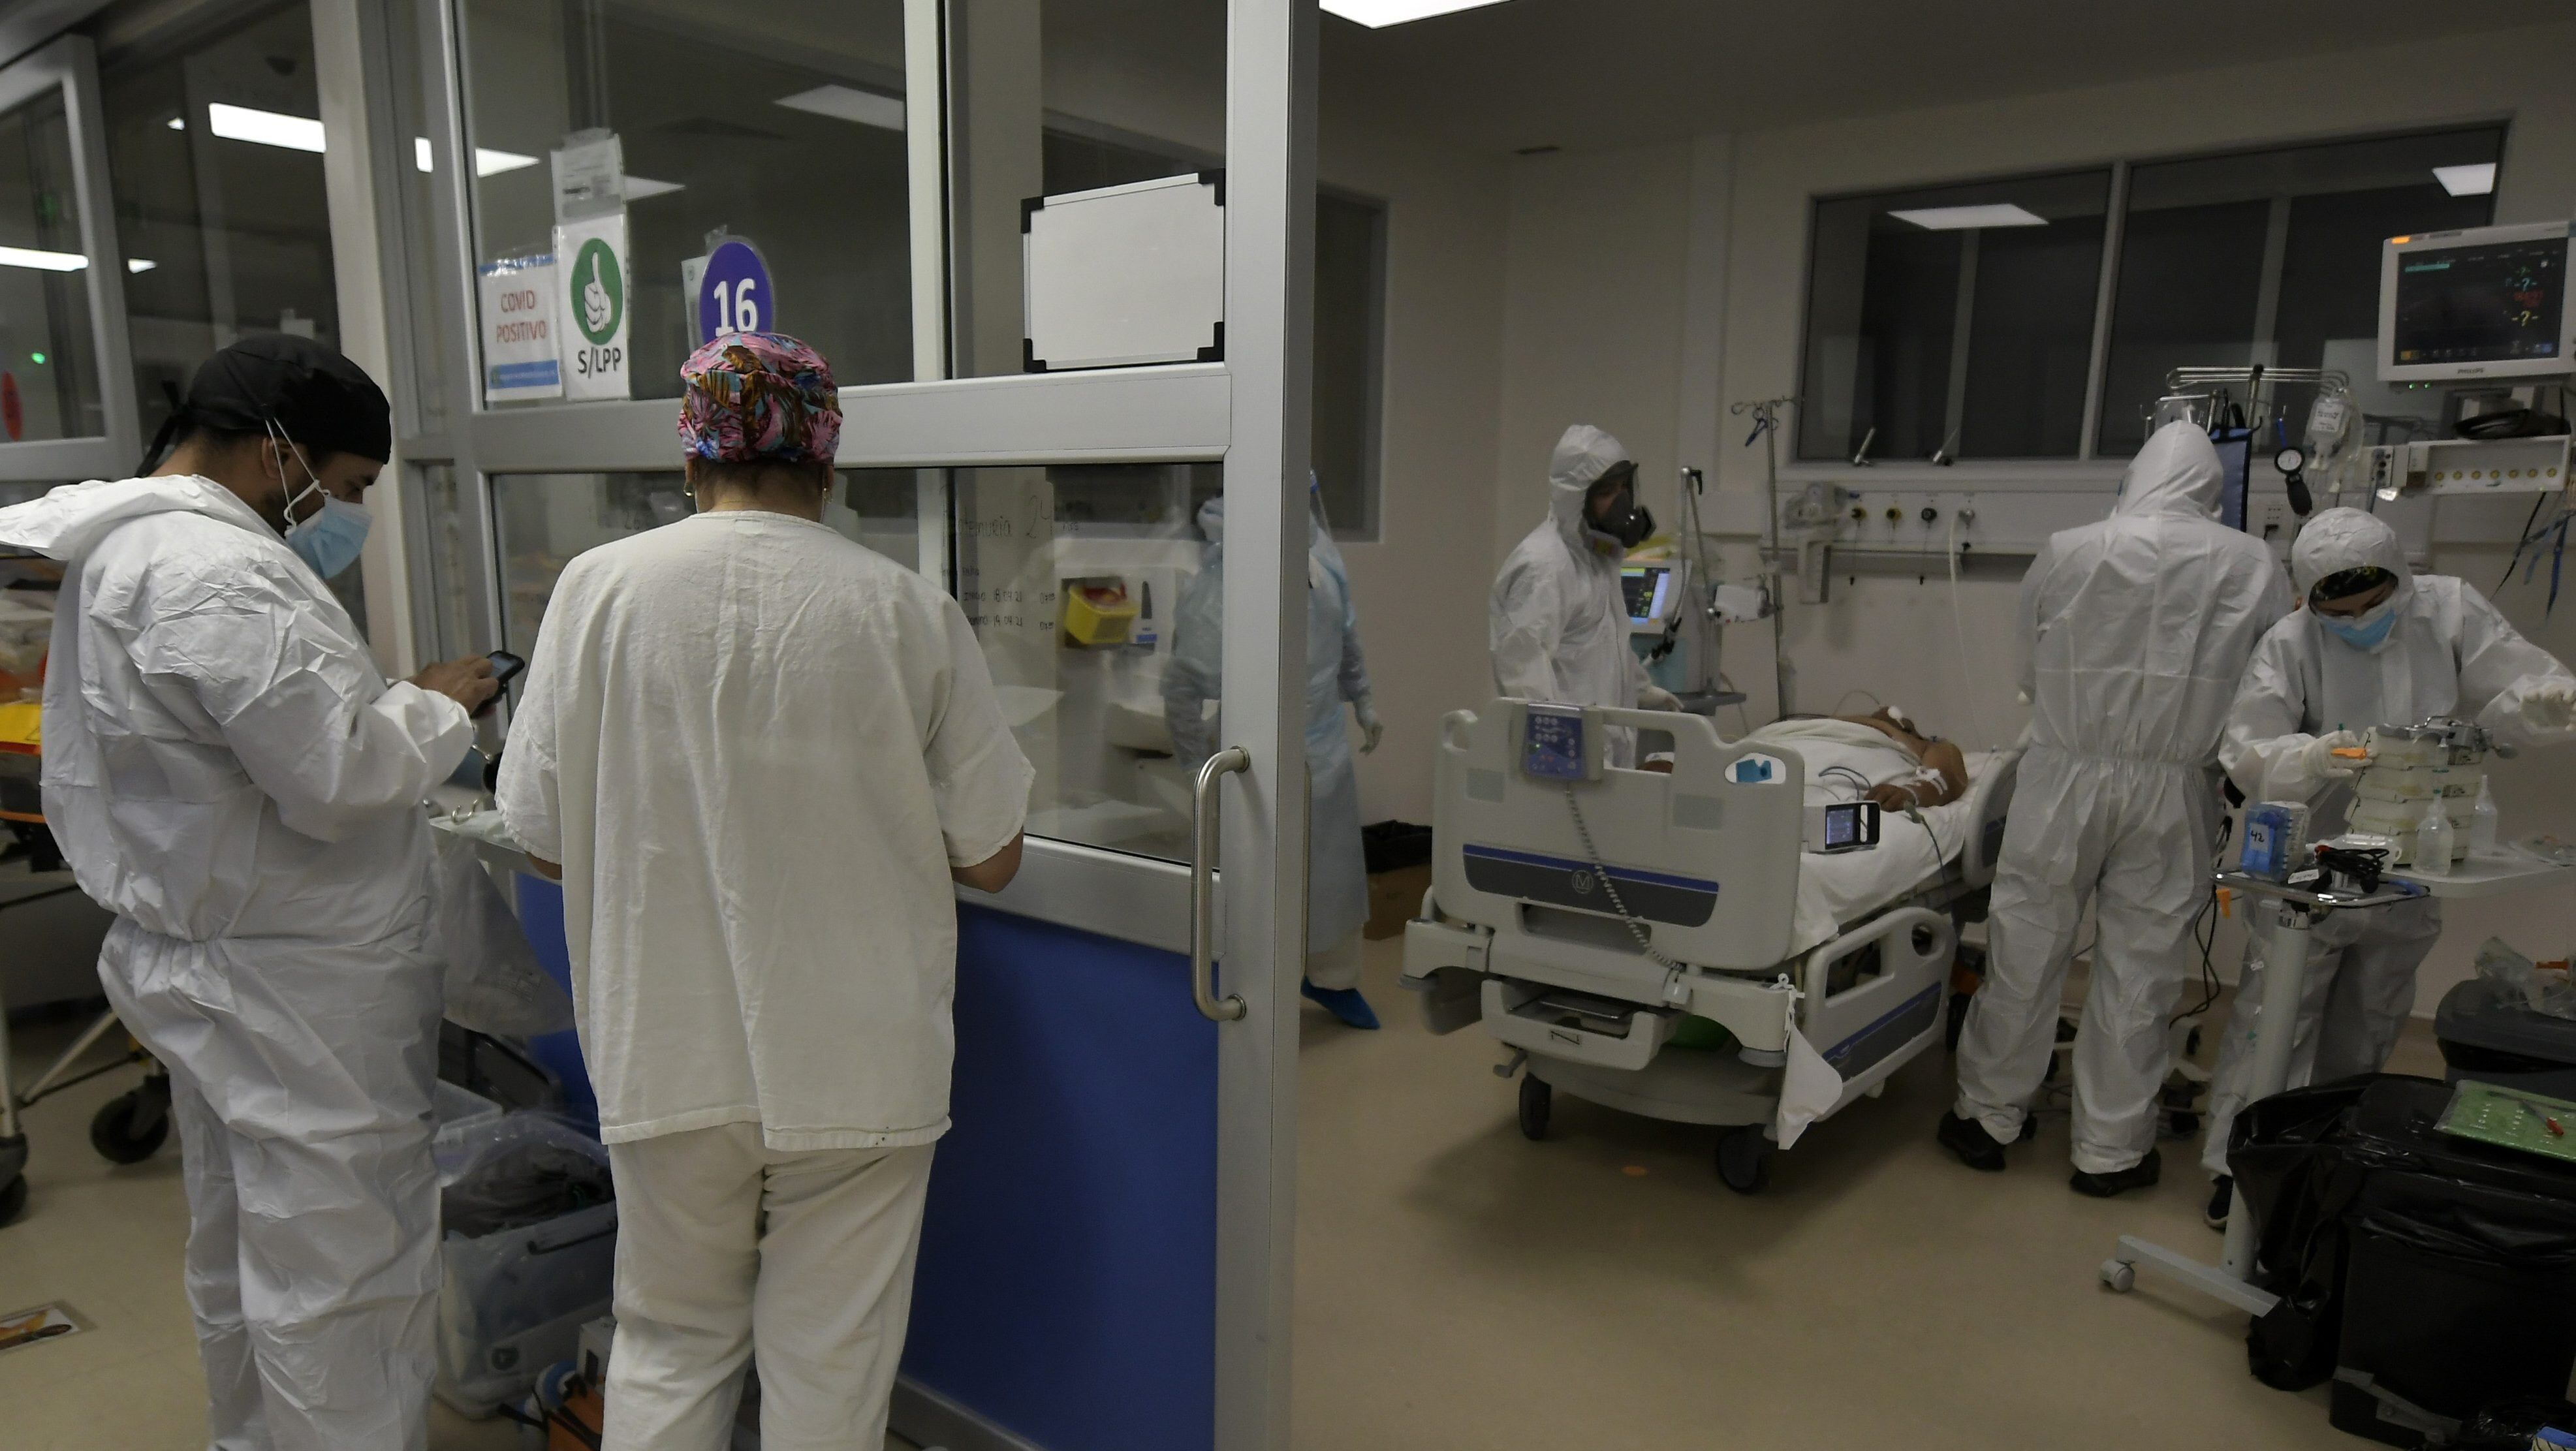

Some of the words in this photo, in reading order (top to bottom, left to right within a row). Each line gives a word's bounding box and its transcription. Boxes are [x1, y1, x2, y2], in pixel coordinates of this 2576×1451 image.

[501, 290, 535, 313] COVID
[714, 278, 757, 337] 16
[496, 320, 547, 343] POSITIVO
[578, 347, 621, 379] S/LPP
[2251, 830, 2265, 843] 42
